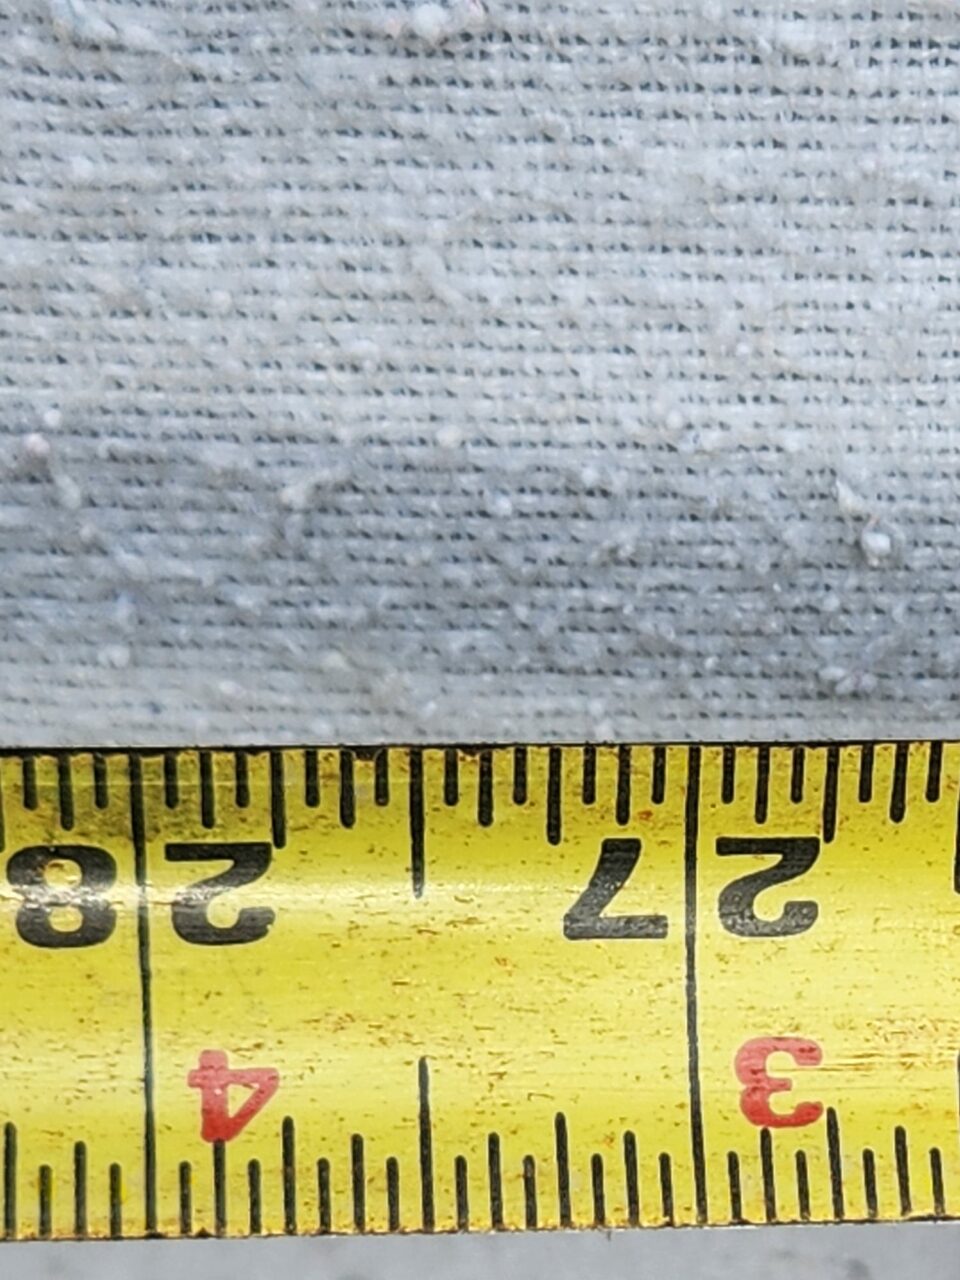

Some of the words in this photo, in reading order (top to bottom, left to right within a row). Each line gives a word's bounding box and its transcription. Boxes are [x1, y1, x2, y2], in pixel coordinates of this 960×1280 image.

[6, 841, 273, 948] 28
[563, 836, 821, 940] 27
[187, 1048, 279, 1143] 4
[733, 1036, 825, 1129] 3
